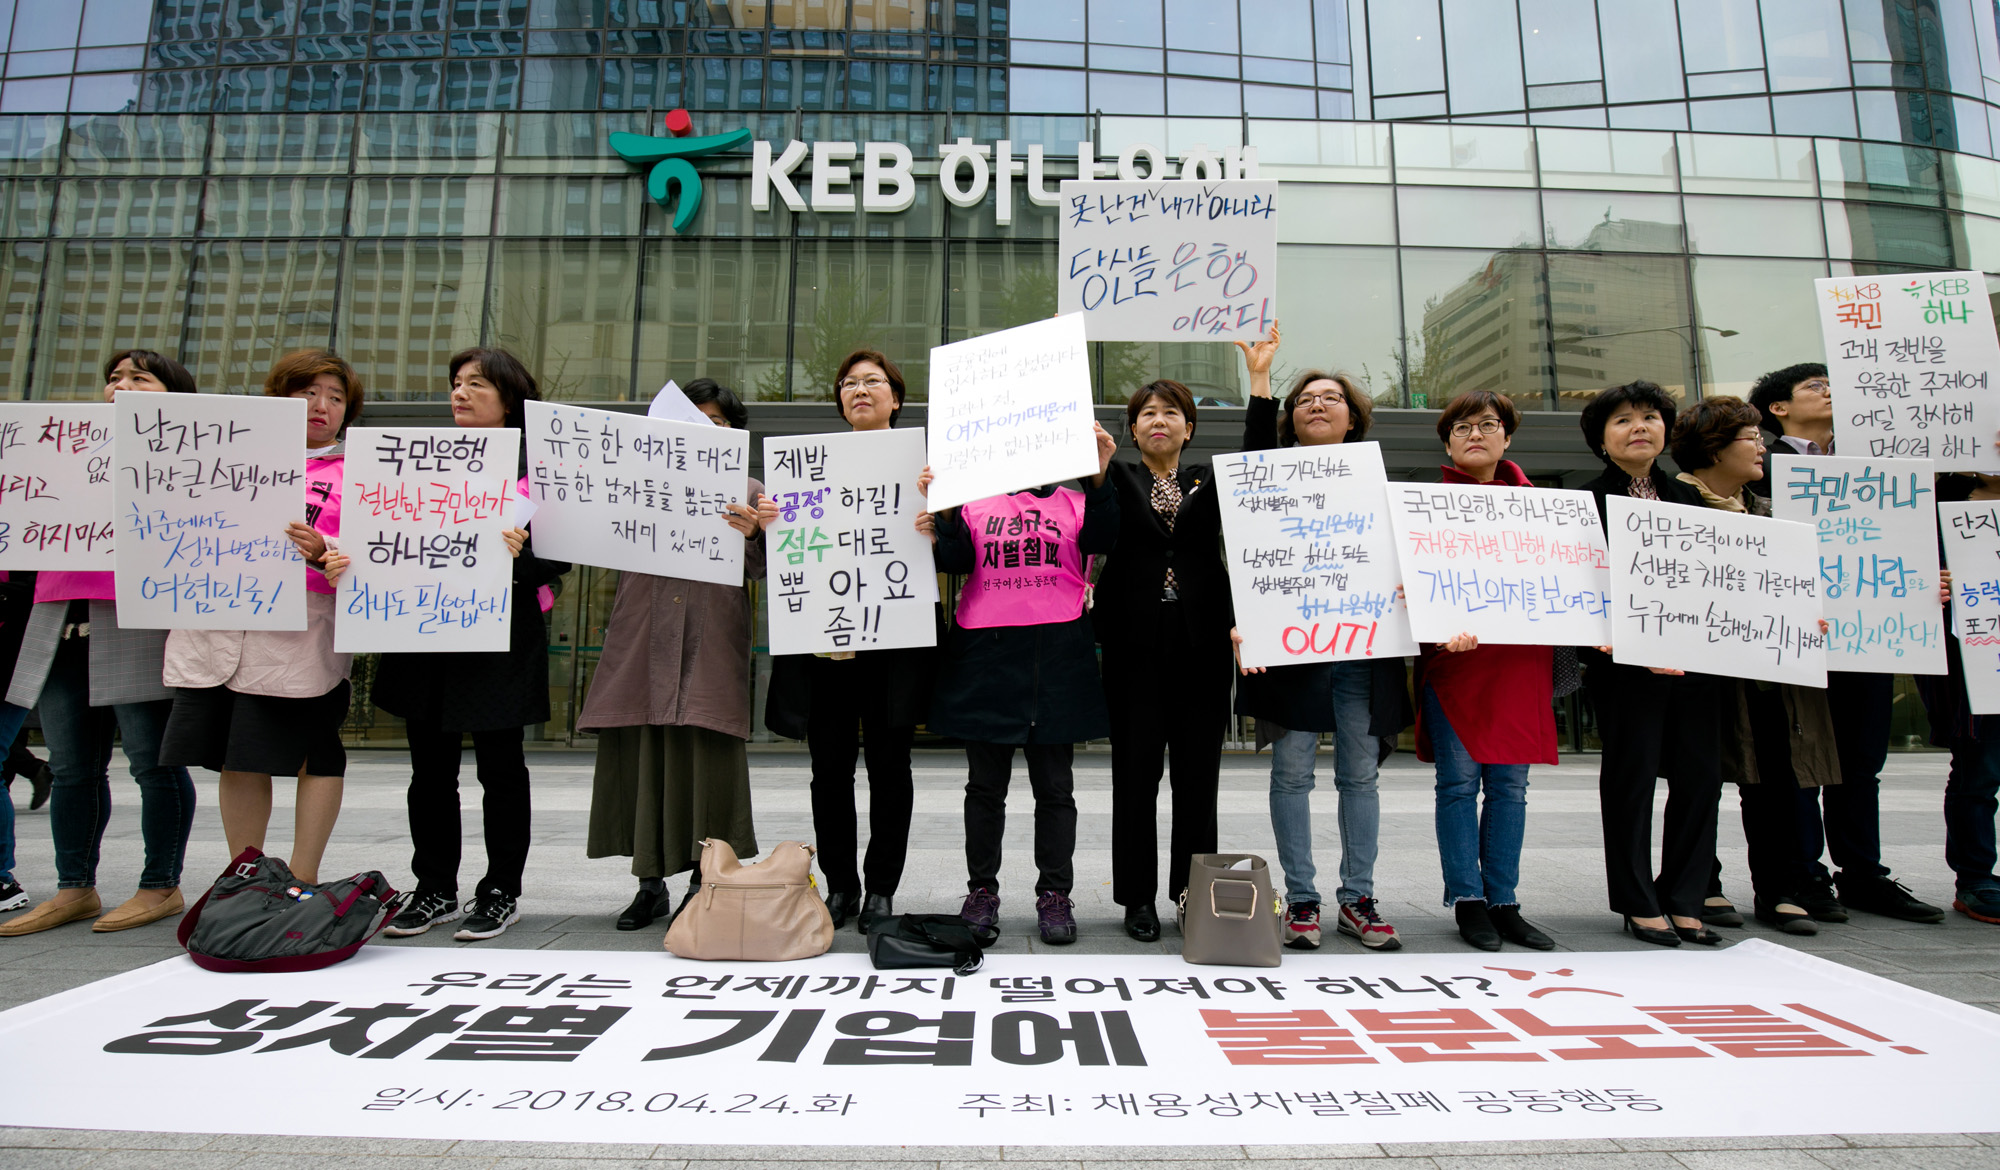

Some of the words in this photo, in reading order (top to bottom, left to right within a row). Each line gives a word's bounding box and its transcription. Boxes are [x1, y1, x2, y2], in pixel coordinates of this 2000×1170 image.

[751, 140, 916, 212] KEB
[1161, 194, 1203, 220] 내가
[1209, 193, 1276, 220] 아니라
[1855, 283, 1882, 300] KB
[1929, 278, 1970, 297] KEB
[1836, 302, 1882, 330] 국민
[1920, 299, 1975, 324] 하나
[1840, 338, 1879, 363] 고객
[1885, 335, 1947, 364] 절반을
[1854, 371, 1911, 399] 우롱한
[1920, 370, 1988, 397] 주제에
[134, 408, 251, 454] 남자가
[1851, 405, 1895, 431] 어딜
[1906, 401, 1973, 430] 장사해
[38, 416, 108, 454] 차별이
[543, 417, 623, 464] 유능한
[633, 434, 687, 471] 여자들
[697, 447, 741, 473] 대신
[1941, 434, 1982, 459] 하나
[376, 434, 488, 476] 국민은행
[774, 445, 828, 481] 제발
[534, 466, 594, 503] 무능한
[605, 477, 672, 511] 남자들을
[1226, 462, 1277, 489] 국민
[1281, 457, 1352, 481] 기만하는
[840, 483, 900, 515] 하길!
[1302, 493, 1325, 509] 기업
[125, 502, 240, 542] 취준에서도
[611, 520, 656, 552] 재미
[1280, 512, 1374, 539] 국민은행!
[1627, 511, 1731, 554] 업무능력이
[1736, 535, 1768, 557] 아닌
[367, 531, 479, 569] 하나은행
[1243, 547, 1295, 568] 남성만
[1304, 543, 1337, 565] 하나
[1341, 545, 1370, 563] 되는
[1320, 573, 1348, 591] 기업
[1630, 551, 1691, 588] 성별로
[1694, 559, 1747, 592] 채용을
[1856, 553, 1929, 598] 사람으로
[345, 575, 410, 621] 하나도
[1297, 591, 1397, 620] 하나은행!
[824, 605, 881, 647] 좀!!
[1282, 621, 1378, 656] OUT!
[407, 971, 632, 998] 우리는
[662, 975, 956, 1000] 언제까지
[989, 975, 1287, 1002] 떨어져야
[1304, 976, 1500, 999] 하나?
[103, 999, 633, 1063] 성차별
[641, 1008, 1148, 1067] 기업에
[361, 1087, 485, 1111] 일시:
[958, 1093, 1072, 1118] 주최:
[1093, 1089, 1452, 1118] 채용성차별철폐
[1457, 1088, 1664, 1114] 공동행동
